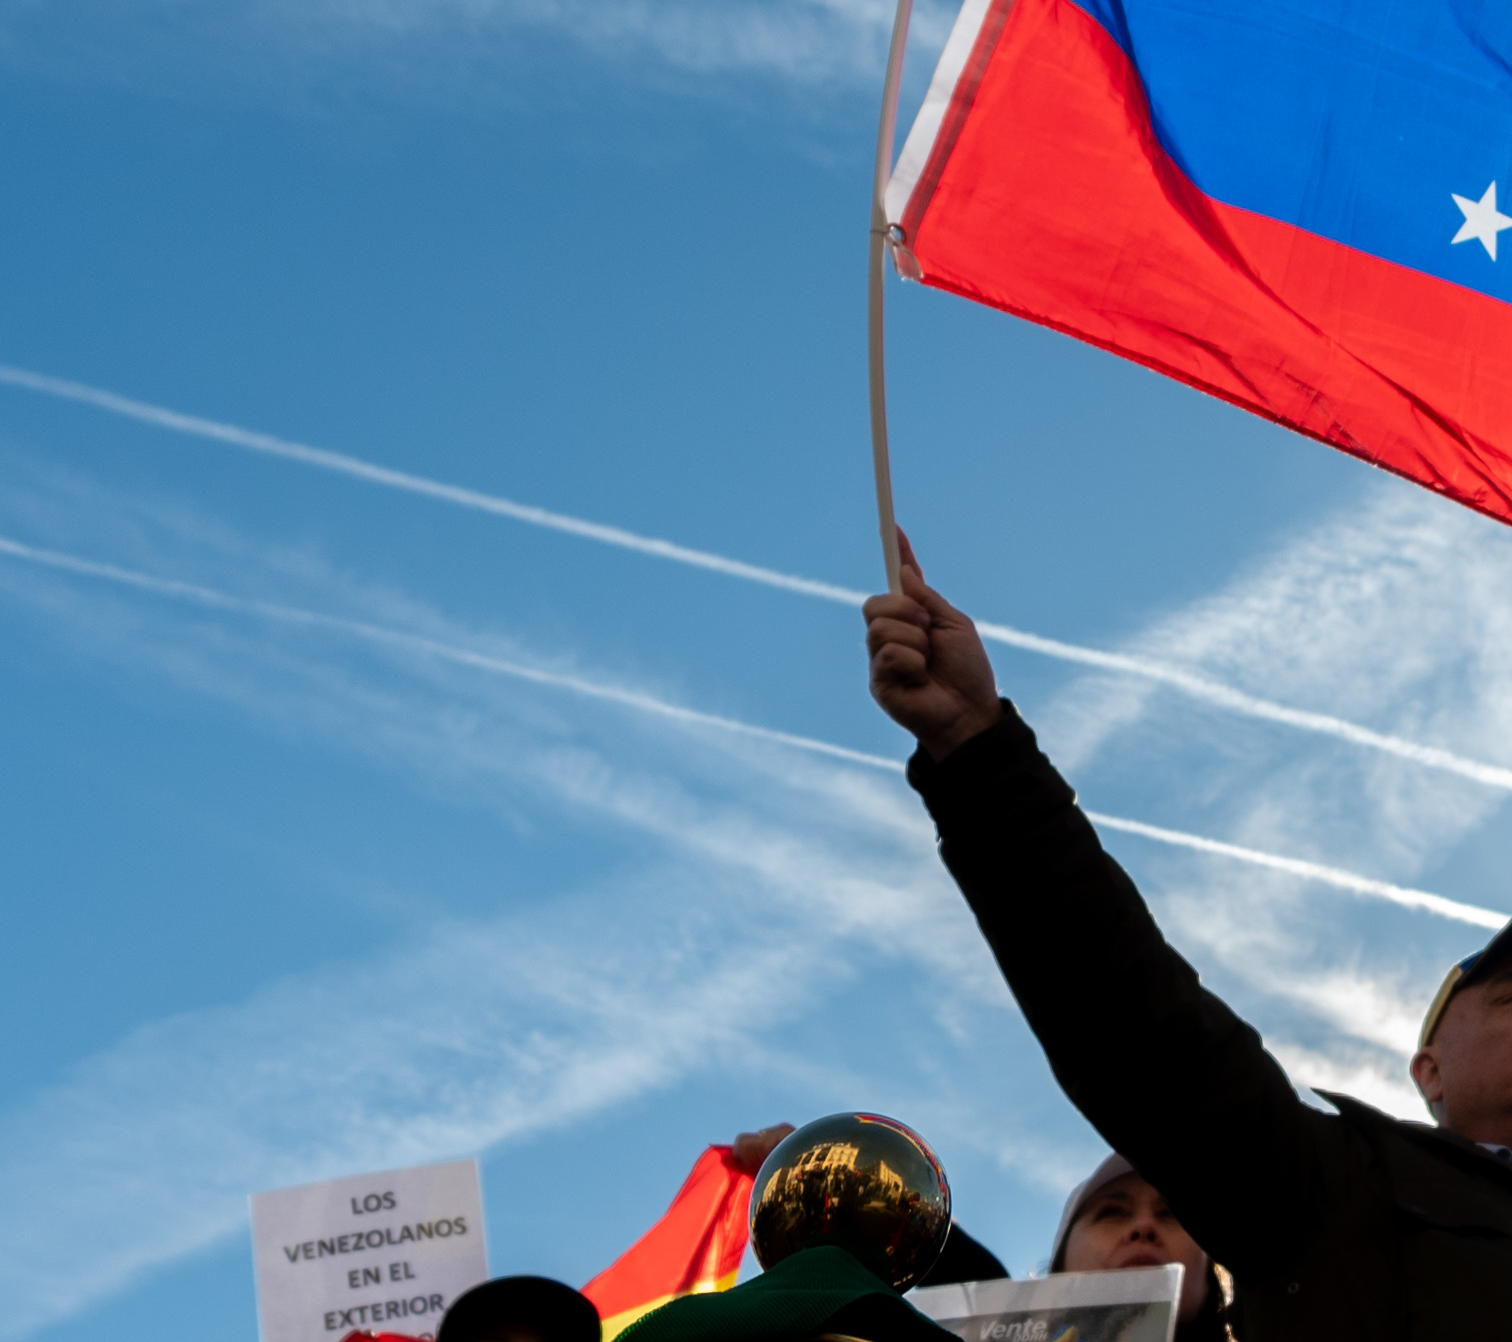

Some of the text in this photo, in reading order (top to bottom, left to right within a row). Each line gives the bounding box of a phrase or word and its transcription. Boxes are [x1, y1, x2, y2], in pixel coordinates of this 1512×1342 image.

[349, 1190, 397, 1216] LOS
[282, 1216, 469, 1264] VENEZOLANOS
[347, 1261, 416, 1291] EN EL
[323, 1293, 446, 1333] EXTERIOR
[979, 1318, 1048, 1340] Vente
